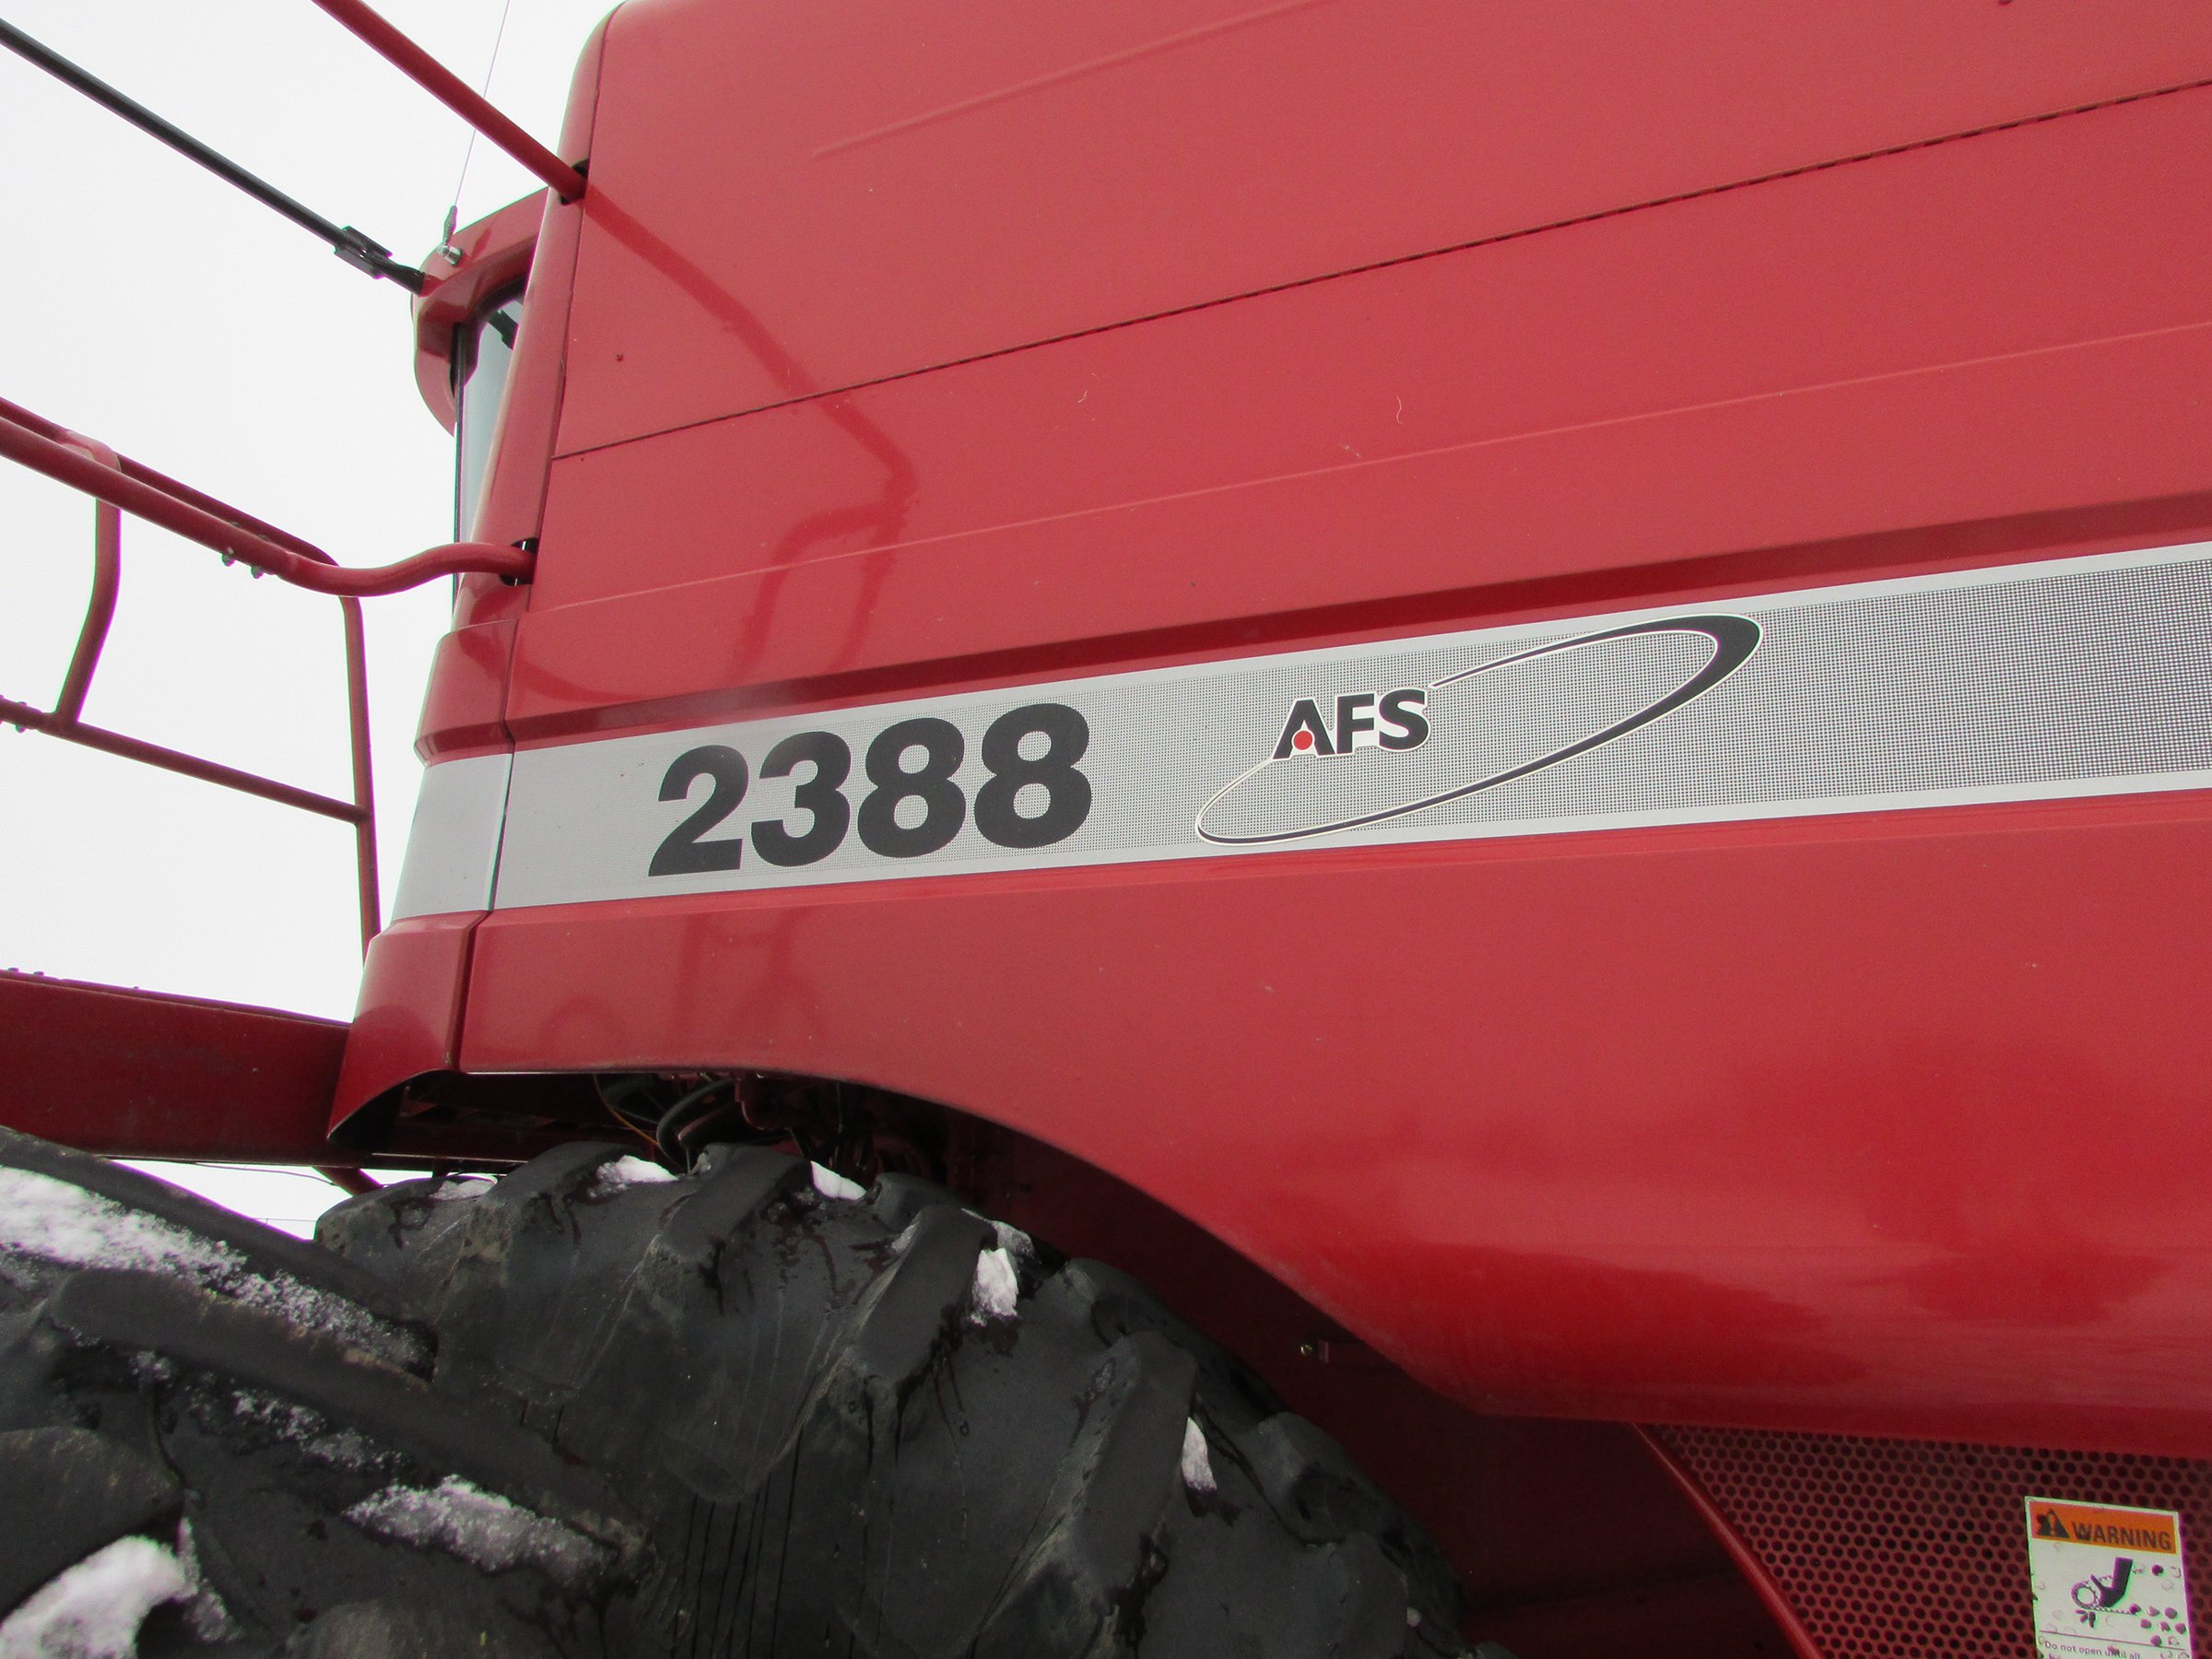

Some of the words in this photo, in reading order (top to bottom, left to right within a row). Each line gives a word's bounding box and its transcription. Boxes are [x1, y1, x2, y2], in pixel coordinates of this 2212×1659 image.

[1278, 690, 1430, 759] AFS
[650, 703, 1091, 876] 2388
[2071, 1521, 2172, 1550] WARNING
[2044, 1641, 2057, 1650] Do
[2060, 1643, 2076, 1653] not
[2078, 1646, 2101, 1656] open
